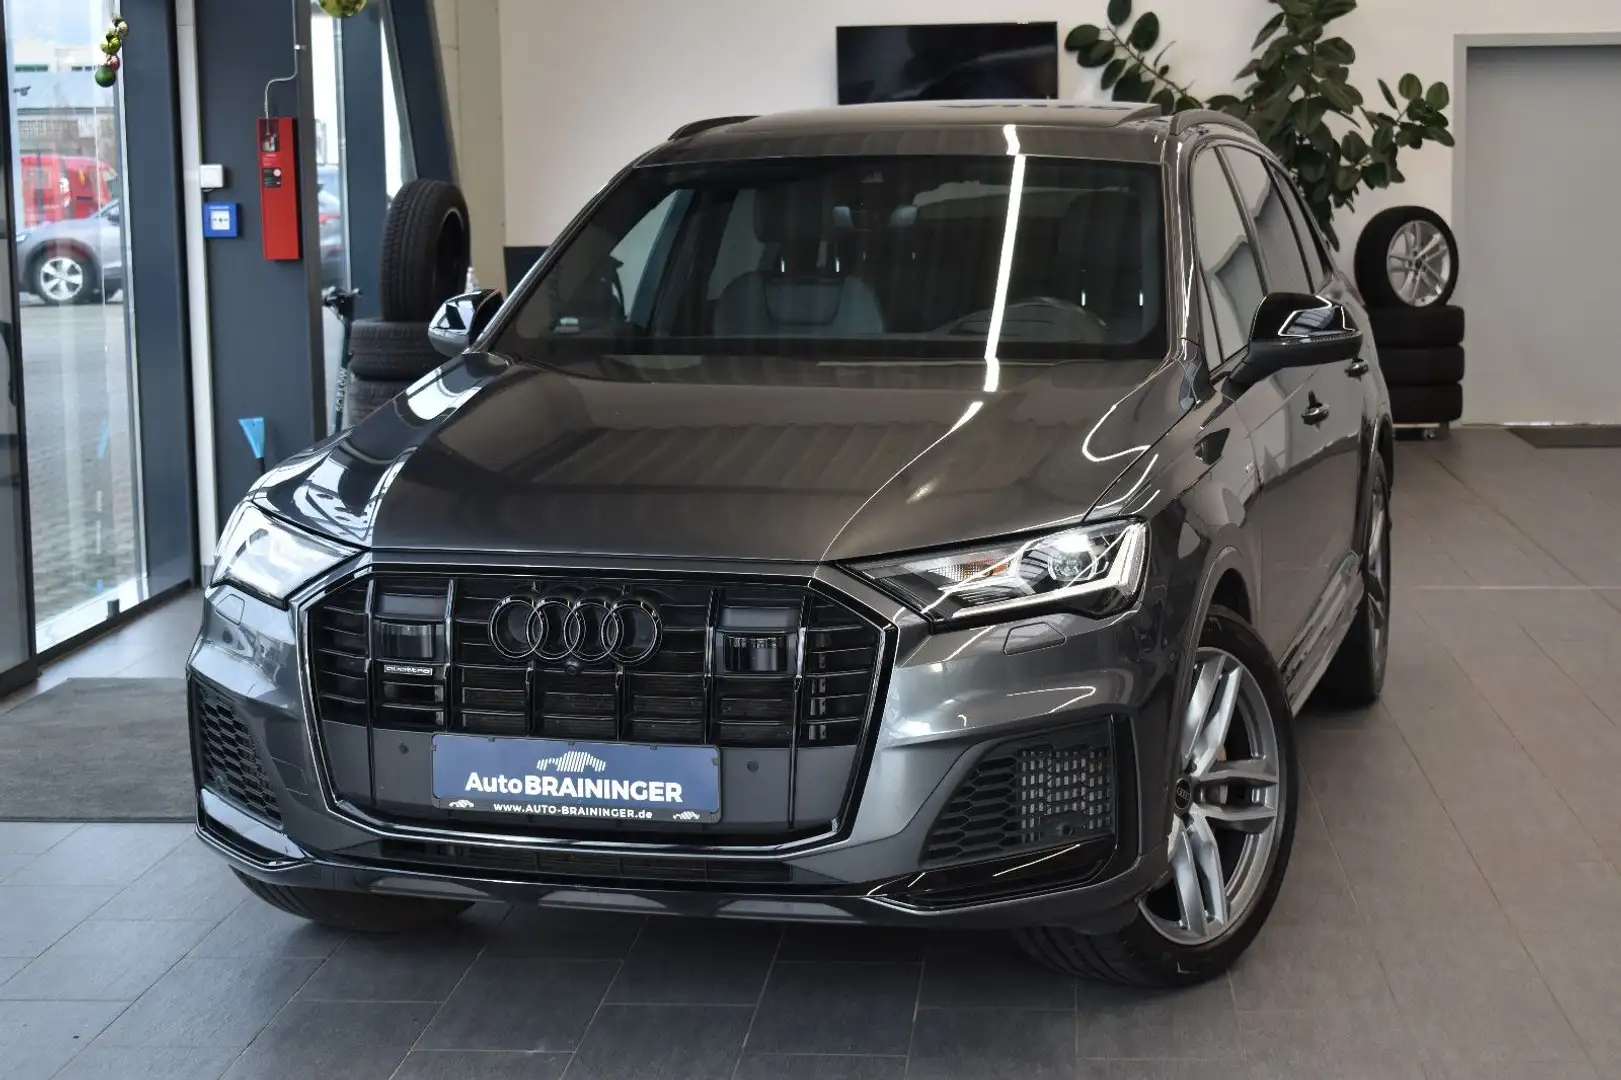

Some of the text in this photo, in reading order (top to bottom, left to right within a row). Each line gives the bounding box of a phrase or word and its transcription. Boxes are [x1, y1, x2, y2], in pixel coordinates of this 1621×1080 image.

[385, 665, 431, 675] quattro
[465, 772, 683, 803] AutoBRAININGER
[493, 803, 653, 819] www.AUTO-BRAININGER.de
